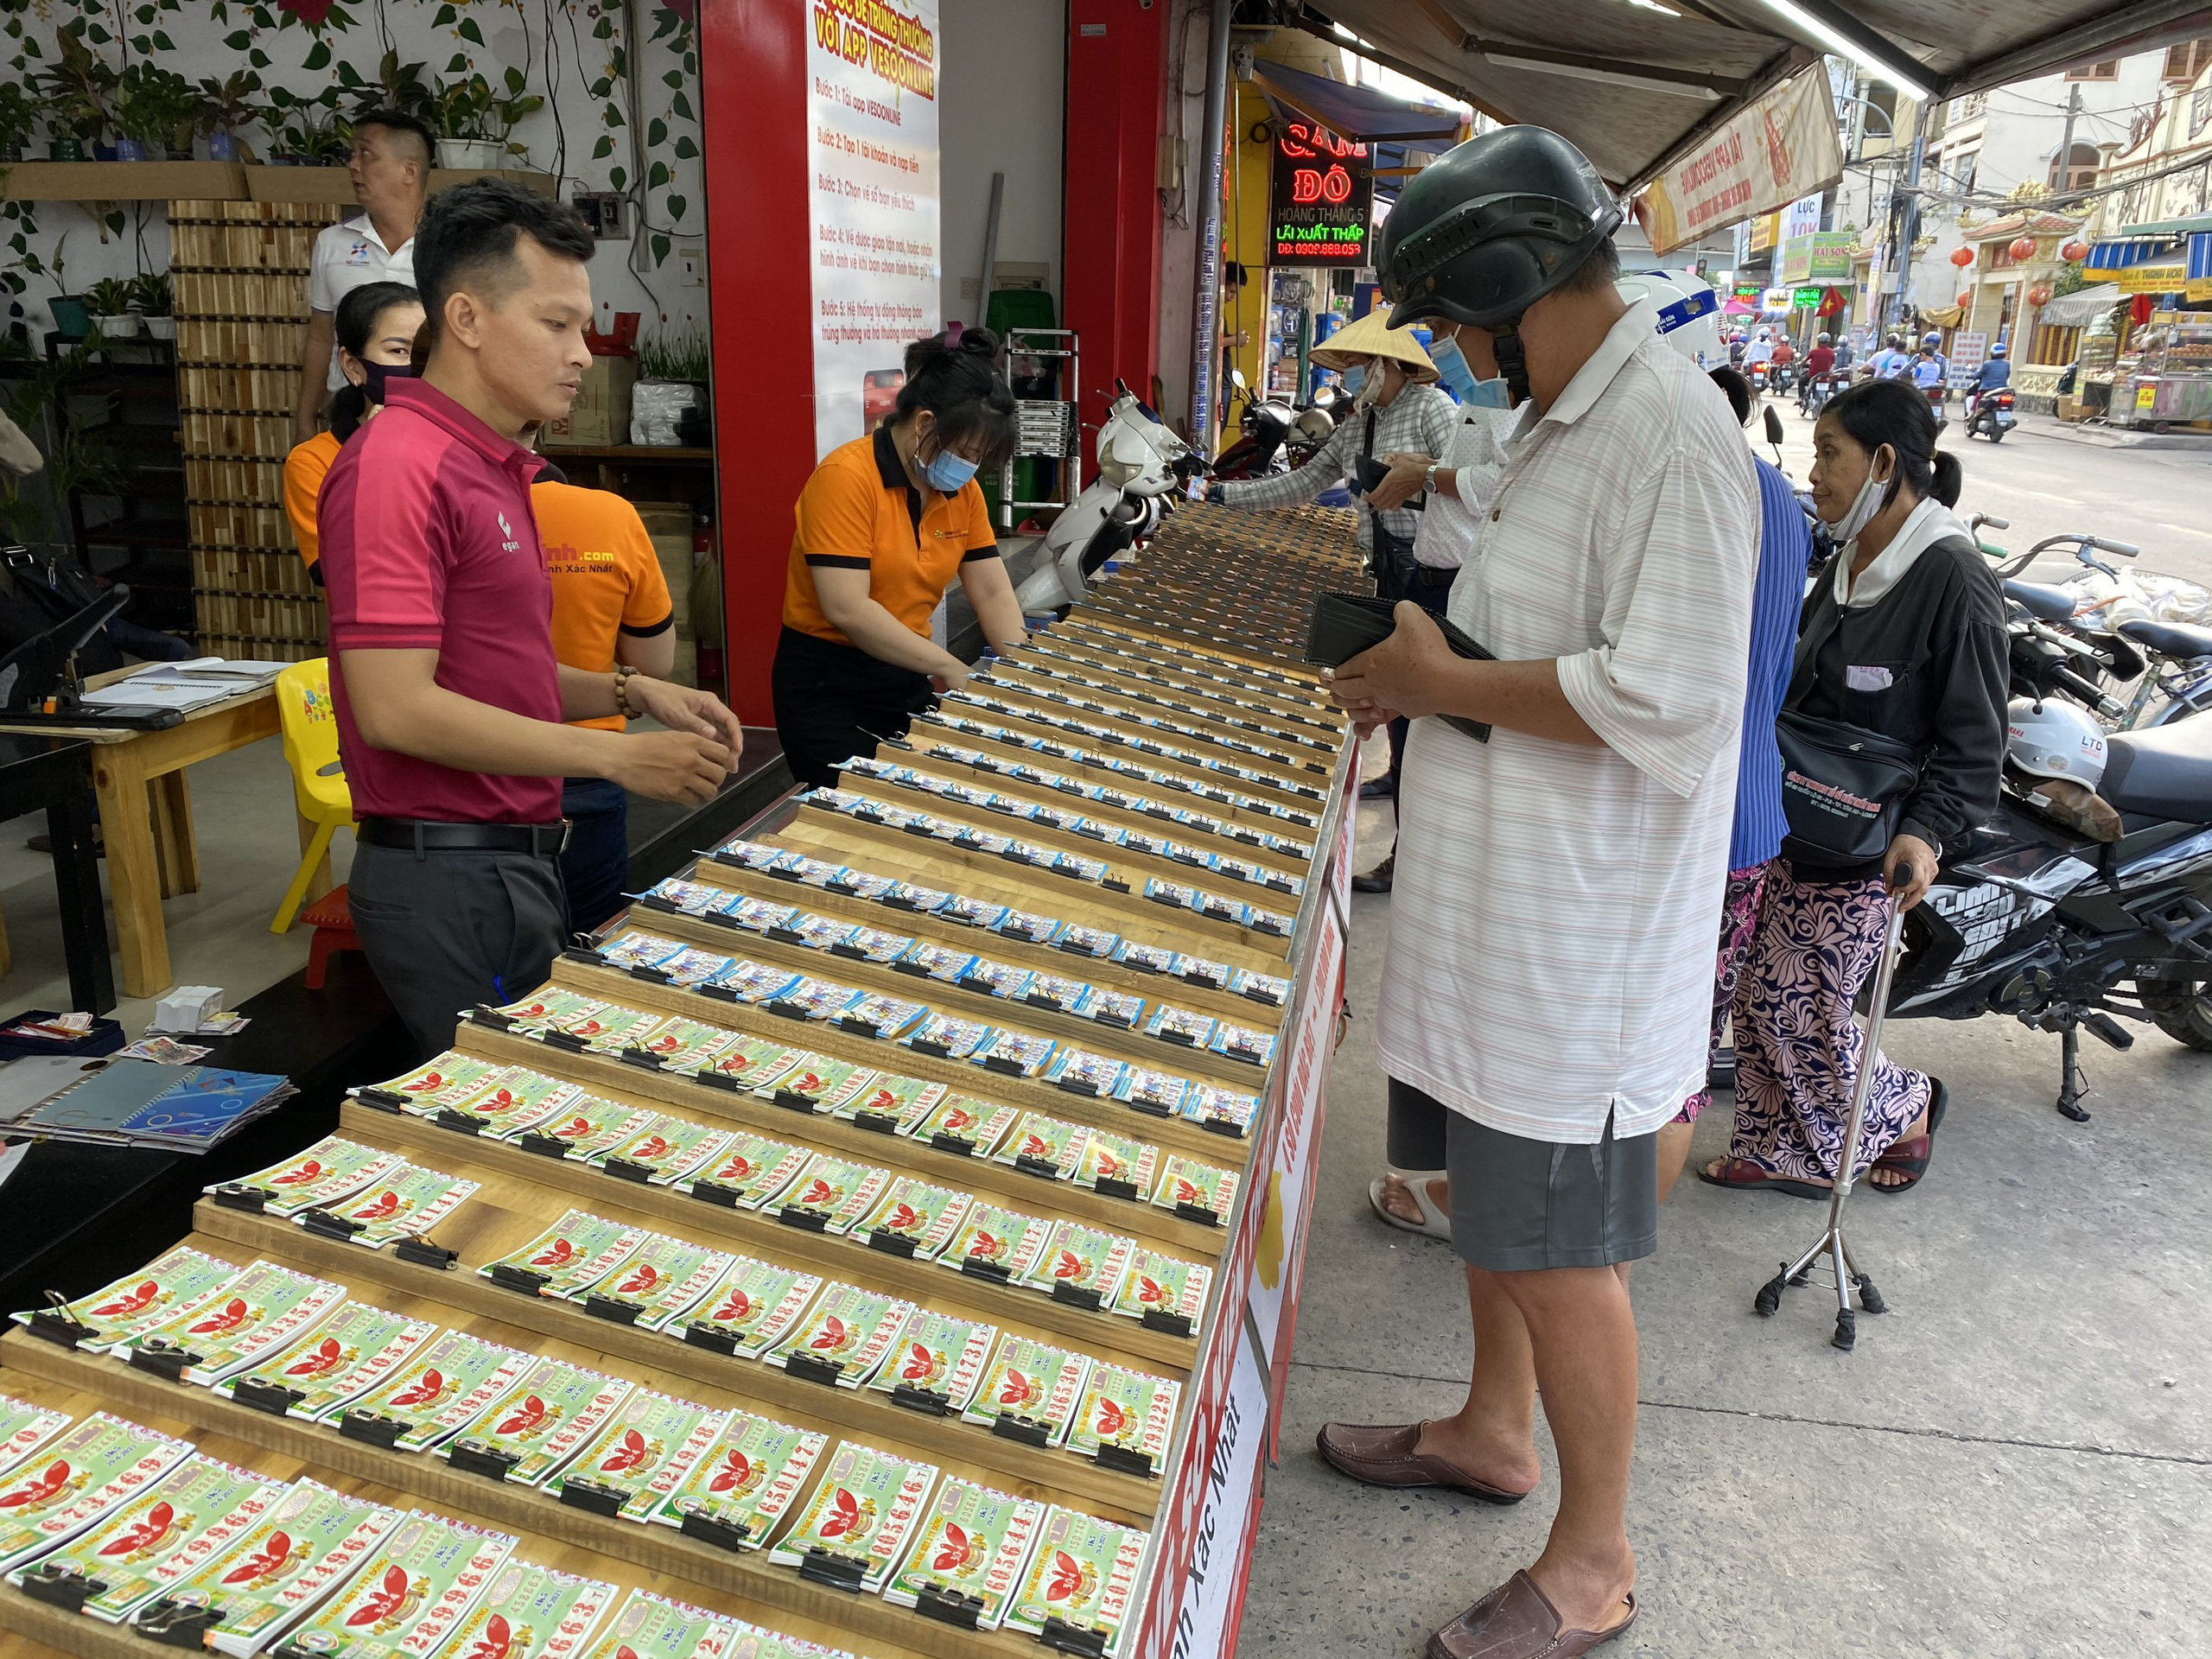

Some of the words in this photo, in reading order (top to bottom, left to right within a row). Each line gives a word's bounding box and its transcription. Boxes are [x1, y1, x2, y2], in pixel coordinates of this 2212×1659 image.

[815, 8, 840, 54] VỚI
[842, 23, 867, 66] APP
[869, 36, 934, 99] VESOONLINE
[868, 0, 898, 42] TRÚNG
[899, 14, 933, 61] THƯỞNG
[816, 76, 833, 99] Bước
[835, 84, 841, 102] 1:
[842, 87, 852, 105] Tải
[853, 97, 865, 115] app
[867, 99, 901, 127] VESOONLINE
[817, 126, 835, 148] Bước
[836, 132, 842, 150] 2:
[843, 135, 855, 157] Tạo
[871, 144, 888, 164] khoản
[889, 150, 897, 167] và
[818, 174, 836, 194] Bước
[837, 180, 843, 195] 3:
[844, 181, 861, 202] Chọn
[862, 184, 869, 200] vé
[871, 184, 879, 203] số
[879, 189, 890, 209] bạn
[1357, 207, 1363, 222] 5
[1798, 200, 1815, 216] LỰC
[820, 224, 836, 243] Bước
[845, 228, 854, 245] Vé
[855, 231, 870, 251] được
[1276, 224, 1294, 240] LÃI
[1297, 222, 1329, 240] XUẤT
[1332, 222, 1365, 241] THẤP
[1278, 243, 1294, 254] DĐ:
[1814, 243, 1828, 257] HẢI
[849, 254, 857, 270] vé
[859, 254, 868, 270] khi
[821, 299, 838, 317] Bước
[840, 302, 846, 318] 5:
[848, 302, 855, 321] Hệ
[822, 324, 839, 345] trúng
[841, 322, 862, 345] thưởng
[863, 325, 871, 340] và
[566, 564, 586, 574] Xác
[589, 563, 613, 574] Nhất
[2082, 735, 2102, 752] LTD
[310, 1160, 386, 1198] 725242
[572, 1237, 634, 1281] 715036
[659, 1263, 717, 1308] 944735
[234, 1296, 324, 1352] 563355
[756, 1286, 810, 1336] 730834
[854, 1312, 902, 1364] 930832
[333, 1334, 418, 1394] 371054
[948, 1338, 986, 1395] 744731
[435, 1367, 517, 1426] 539851
[1045, 1365, 1081, 1421] 936530
[545, 1395, 615, 1454] 463050
[1142, 1394, 1172, 1451] 793229
[1211, 1391, 1241, 1507] Nhất
[650, 1426, 716, 1492] 621948
[758, 1444, 816, 1515] 650147
[41, 1458, 162, 1532] 673469
[871, 1480, 924, 1556] 805646
[156, 1500, 264, 1579] 479968
[282, 1522, 381, 1602] 444967
[983, 1515, 1033, 1591] 605644
[402, 1555, 495, 1651] 289966
[1098, 1544, 1141, 1620] 150143
